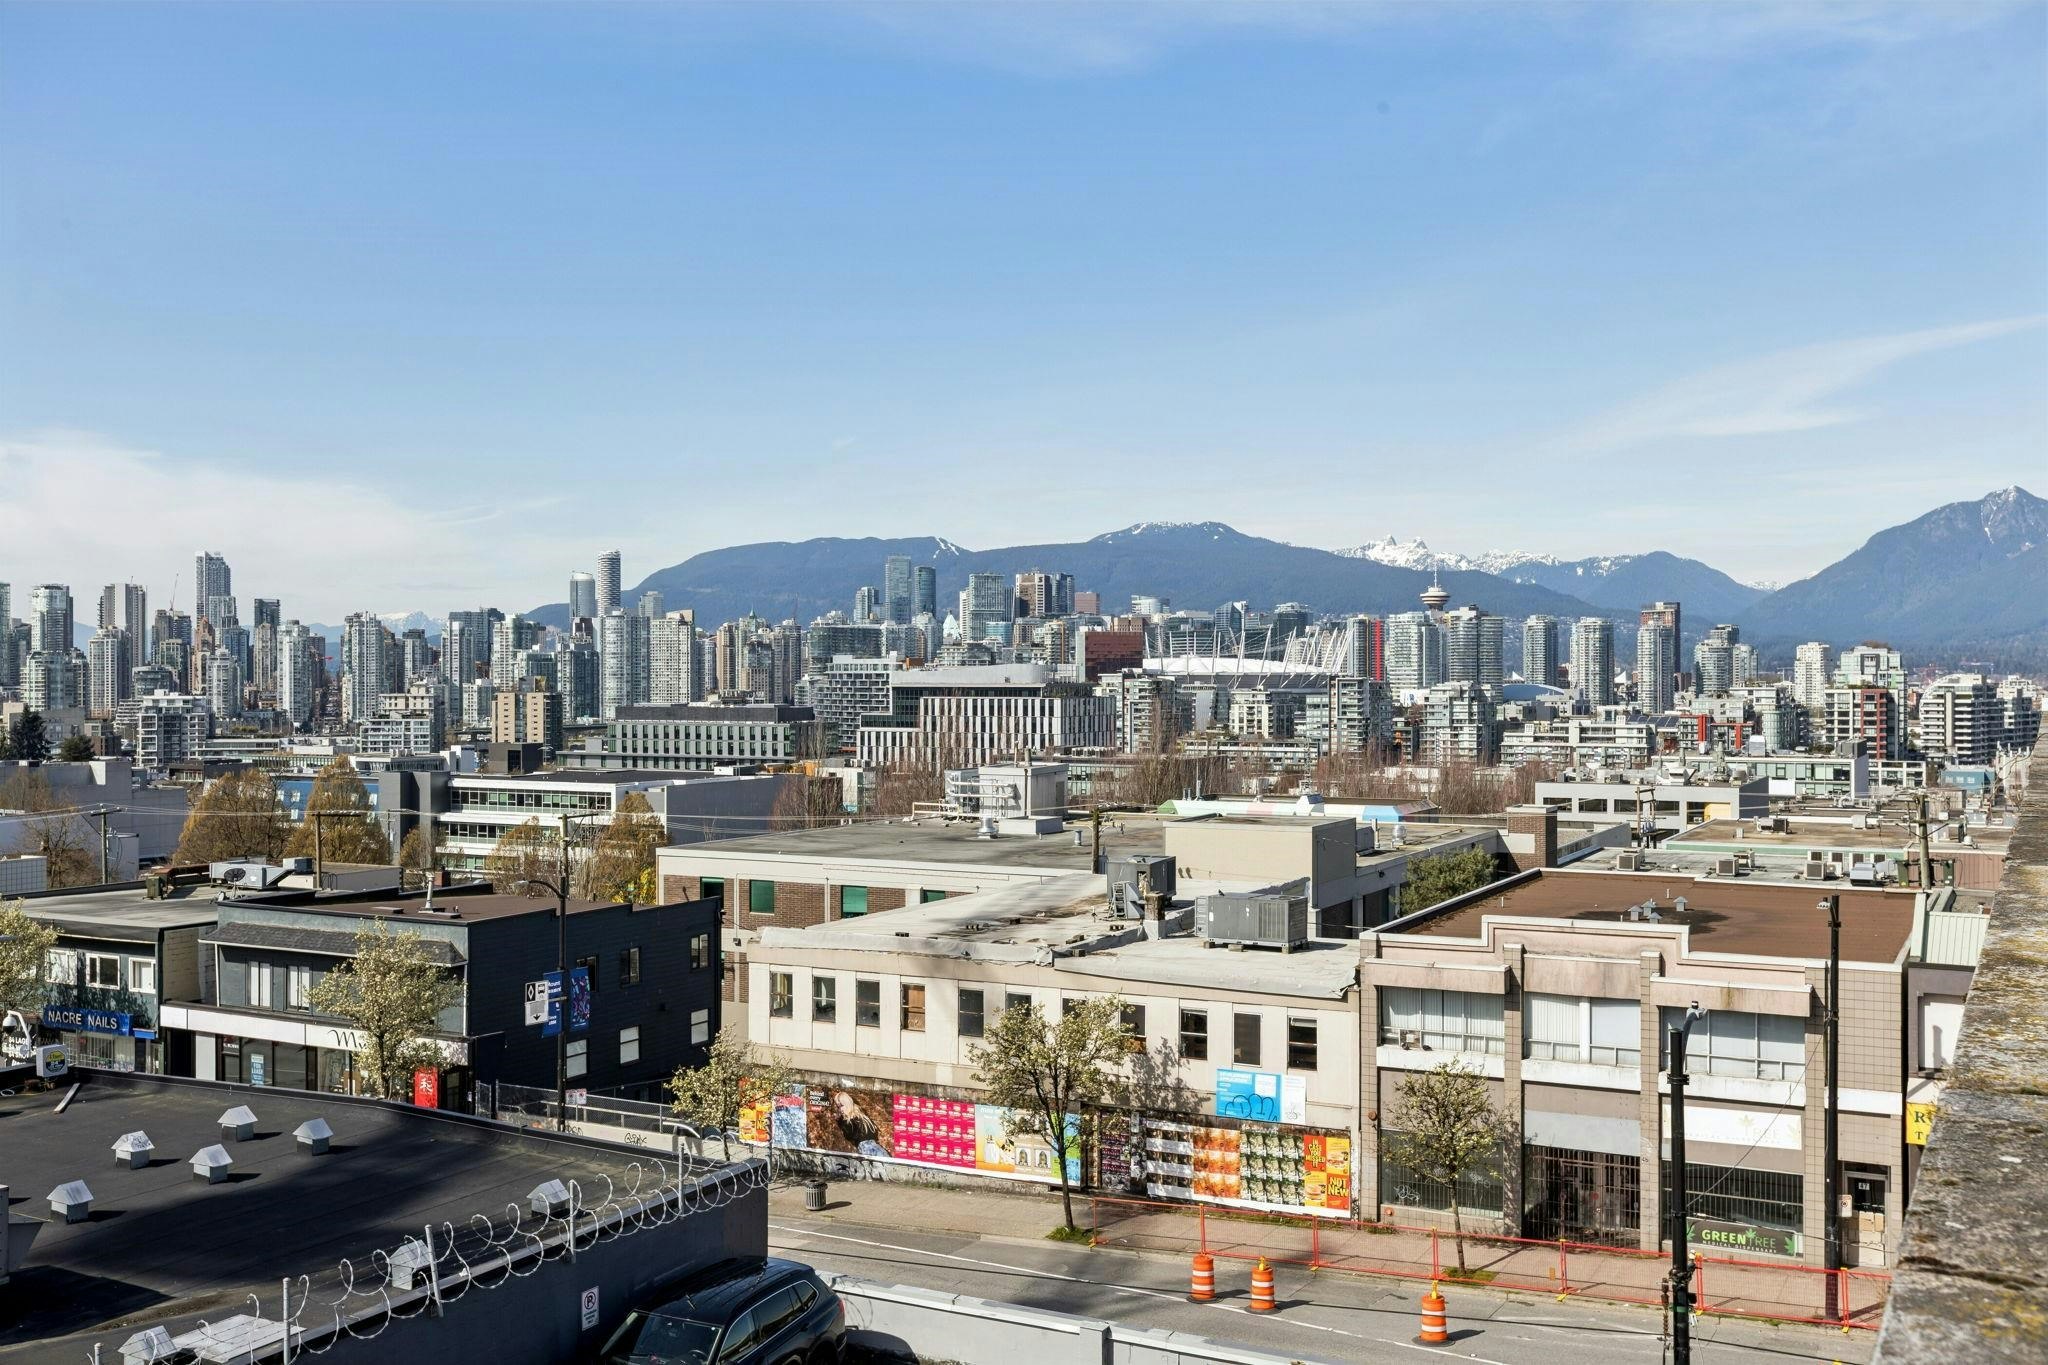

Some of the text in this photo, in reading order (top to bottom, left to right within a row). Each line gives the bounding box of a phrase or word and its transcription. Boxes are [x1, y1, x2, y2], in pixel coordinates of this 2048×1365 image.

[48, 1010, 118, 1030] NACRE NAILS
[1329, 1177, 1348, 1189] NOT
[1327, 1185, 1349, 1197] NEW
[1702, 1240, 1777, 1253] MEDICAL DISPENSARY
